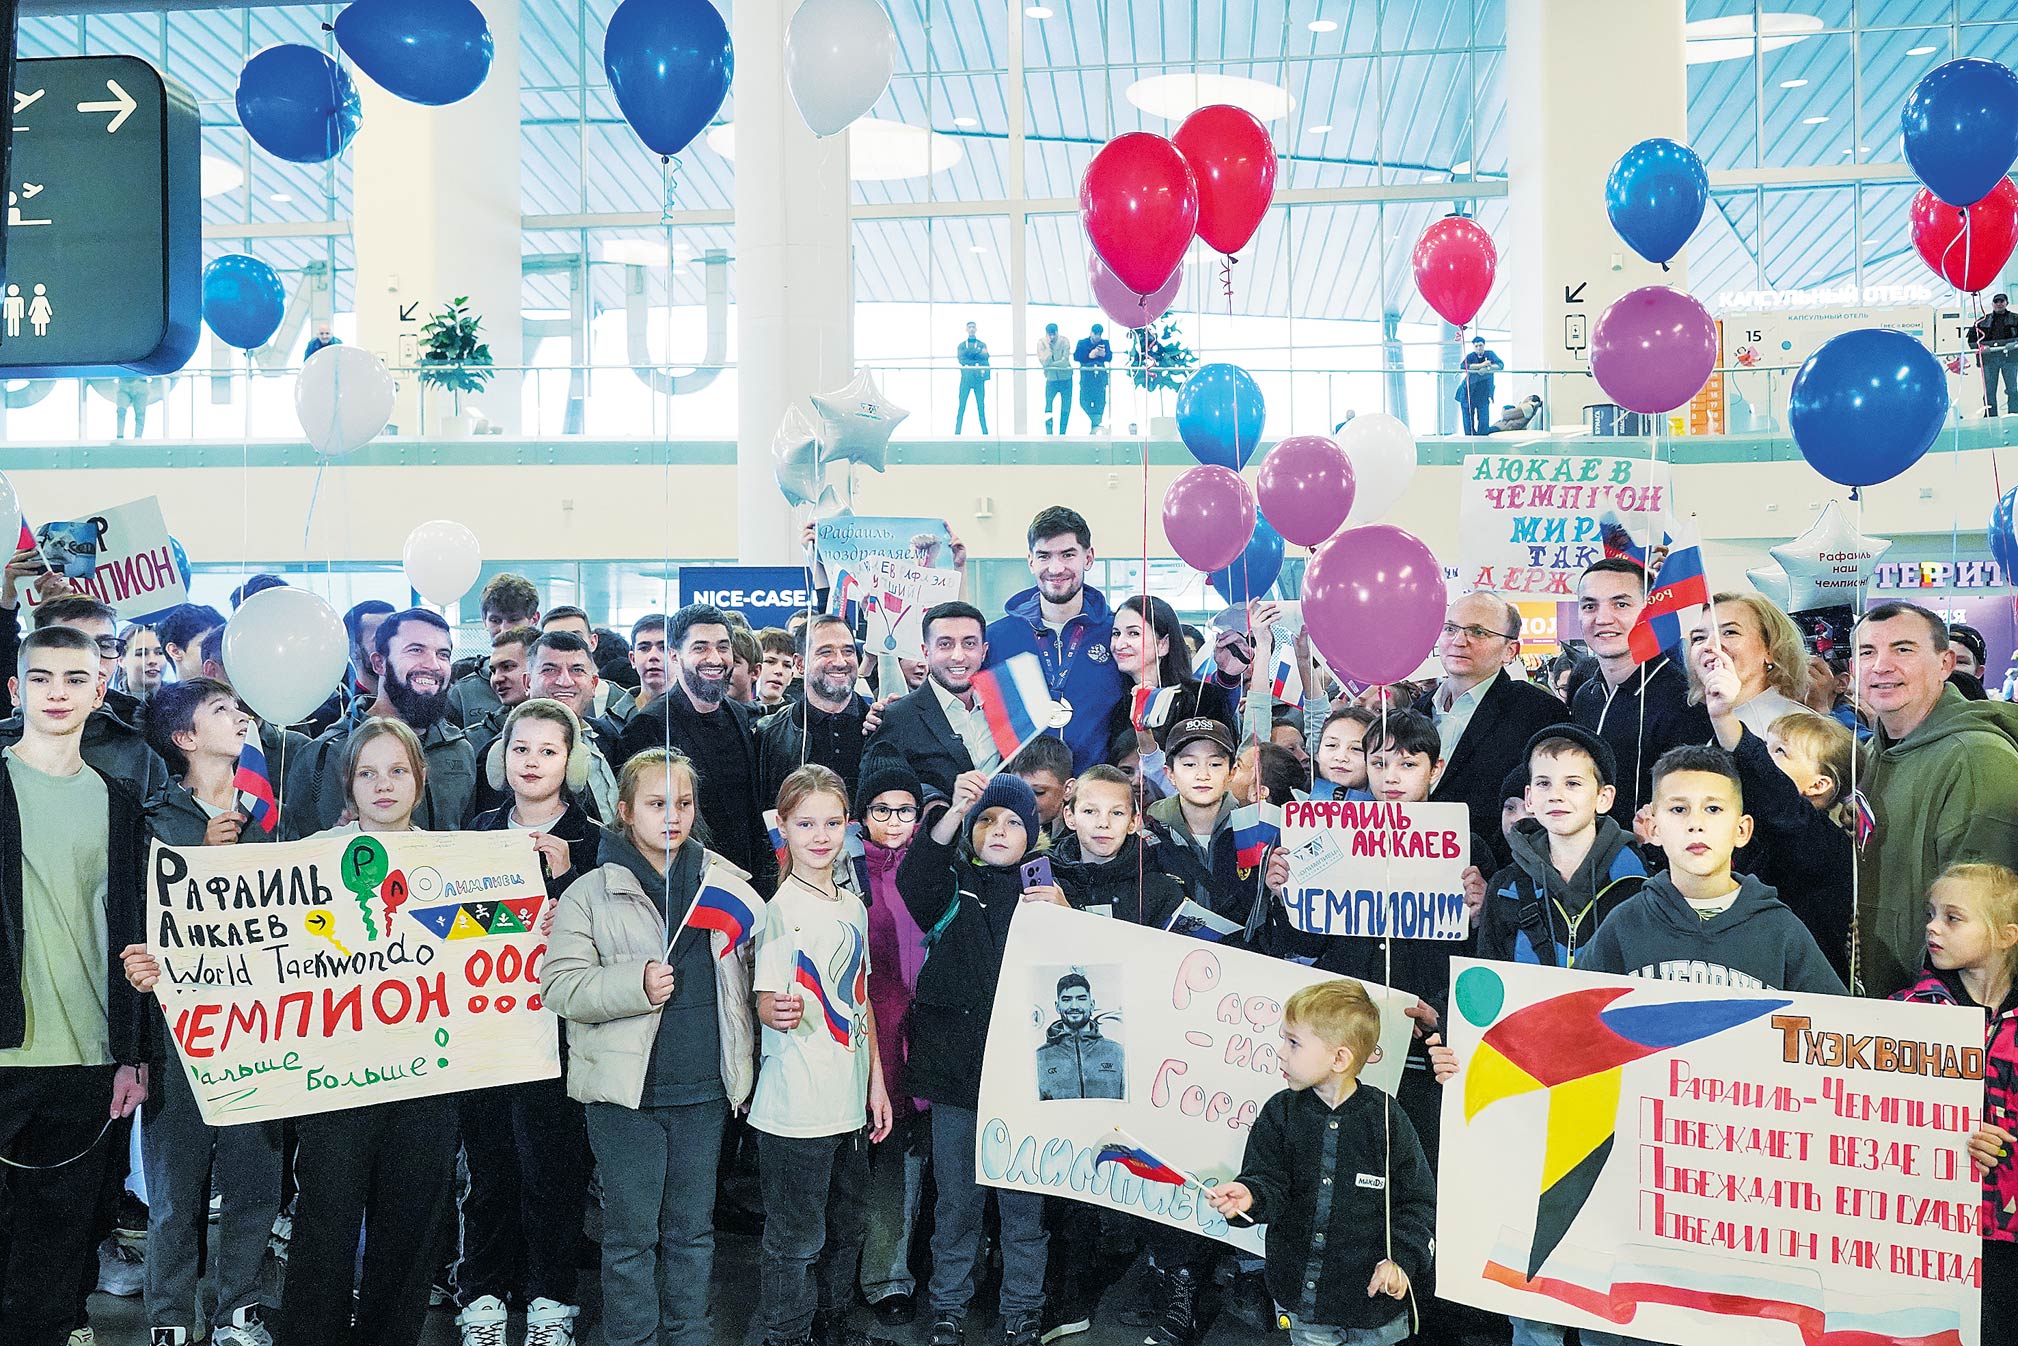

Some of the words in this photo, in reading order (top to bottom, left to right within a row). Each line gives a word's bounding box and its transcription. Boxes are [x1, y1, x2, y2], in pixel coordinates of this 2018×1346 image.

[1863, 284, 1932, 302] ОТЕЛЬ
[1788, 313, 1842, 321] КАПСУЛЬНЫЙ
[1746, 331, 1762, 342] 15
[1472, 457, 1633, 485] АЮКАЕВ
[1485, 484, 1664, 512] ЧЕМПИОН
[820, 522, 895, 547] Рафаиль,
[1510, 516, 1602, 543] МИР
[1527, 545, 1599, 568] ТАК
[1819, 551, 1871, 563] Рафаиль
[1832, 565, 1858, 574] наш
[26, 546, 176, 606] МПИОН
[1472, 566, 1577, 594] ДЕРЖ
[1815, 577, 1869, 588] чемпион!
[1874, 561, 2003, 589] ТЕРРИТ
[1186, 719, 1213, 728] BOSS
[1286, 801, 1412, 830] РАФАИЛЬ
[156, 847, 332, 911] РАФАИЛЬ
[164, 950, 253, 985] World
[262, 931, 435, 984] Taekwondo
[1173, 949, 1281, 1033] РАФ
[1771, 1015, 1985, 1080] ТХЭКВОНДО
[192, 1051, 303, 1086] альше
[1151, 1058, 1258, 1130] ГОРД
[1639, 1096, 1813, 1162] ПОБЕЖДАЕТ
[1829, 1134, 1920, 1177] ВЕЗДЕ
[1639, 1143, 1821, 1212] ПОБЕЖДАТЬ
[1836, 1185, 1888, 1221] ЕГО
[1779, 1228, 1818, 1260] ОН
[1831, 1236, 1881, 1271] КАК
